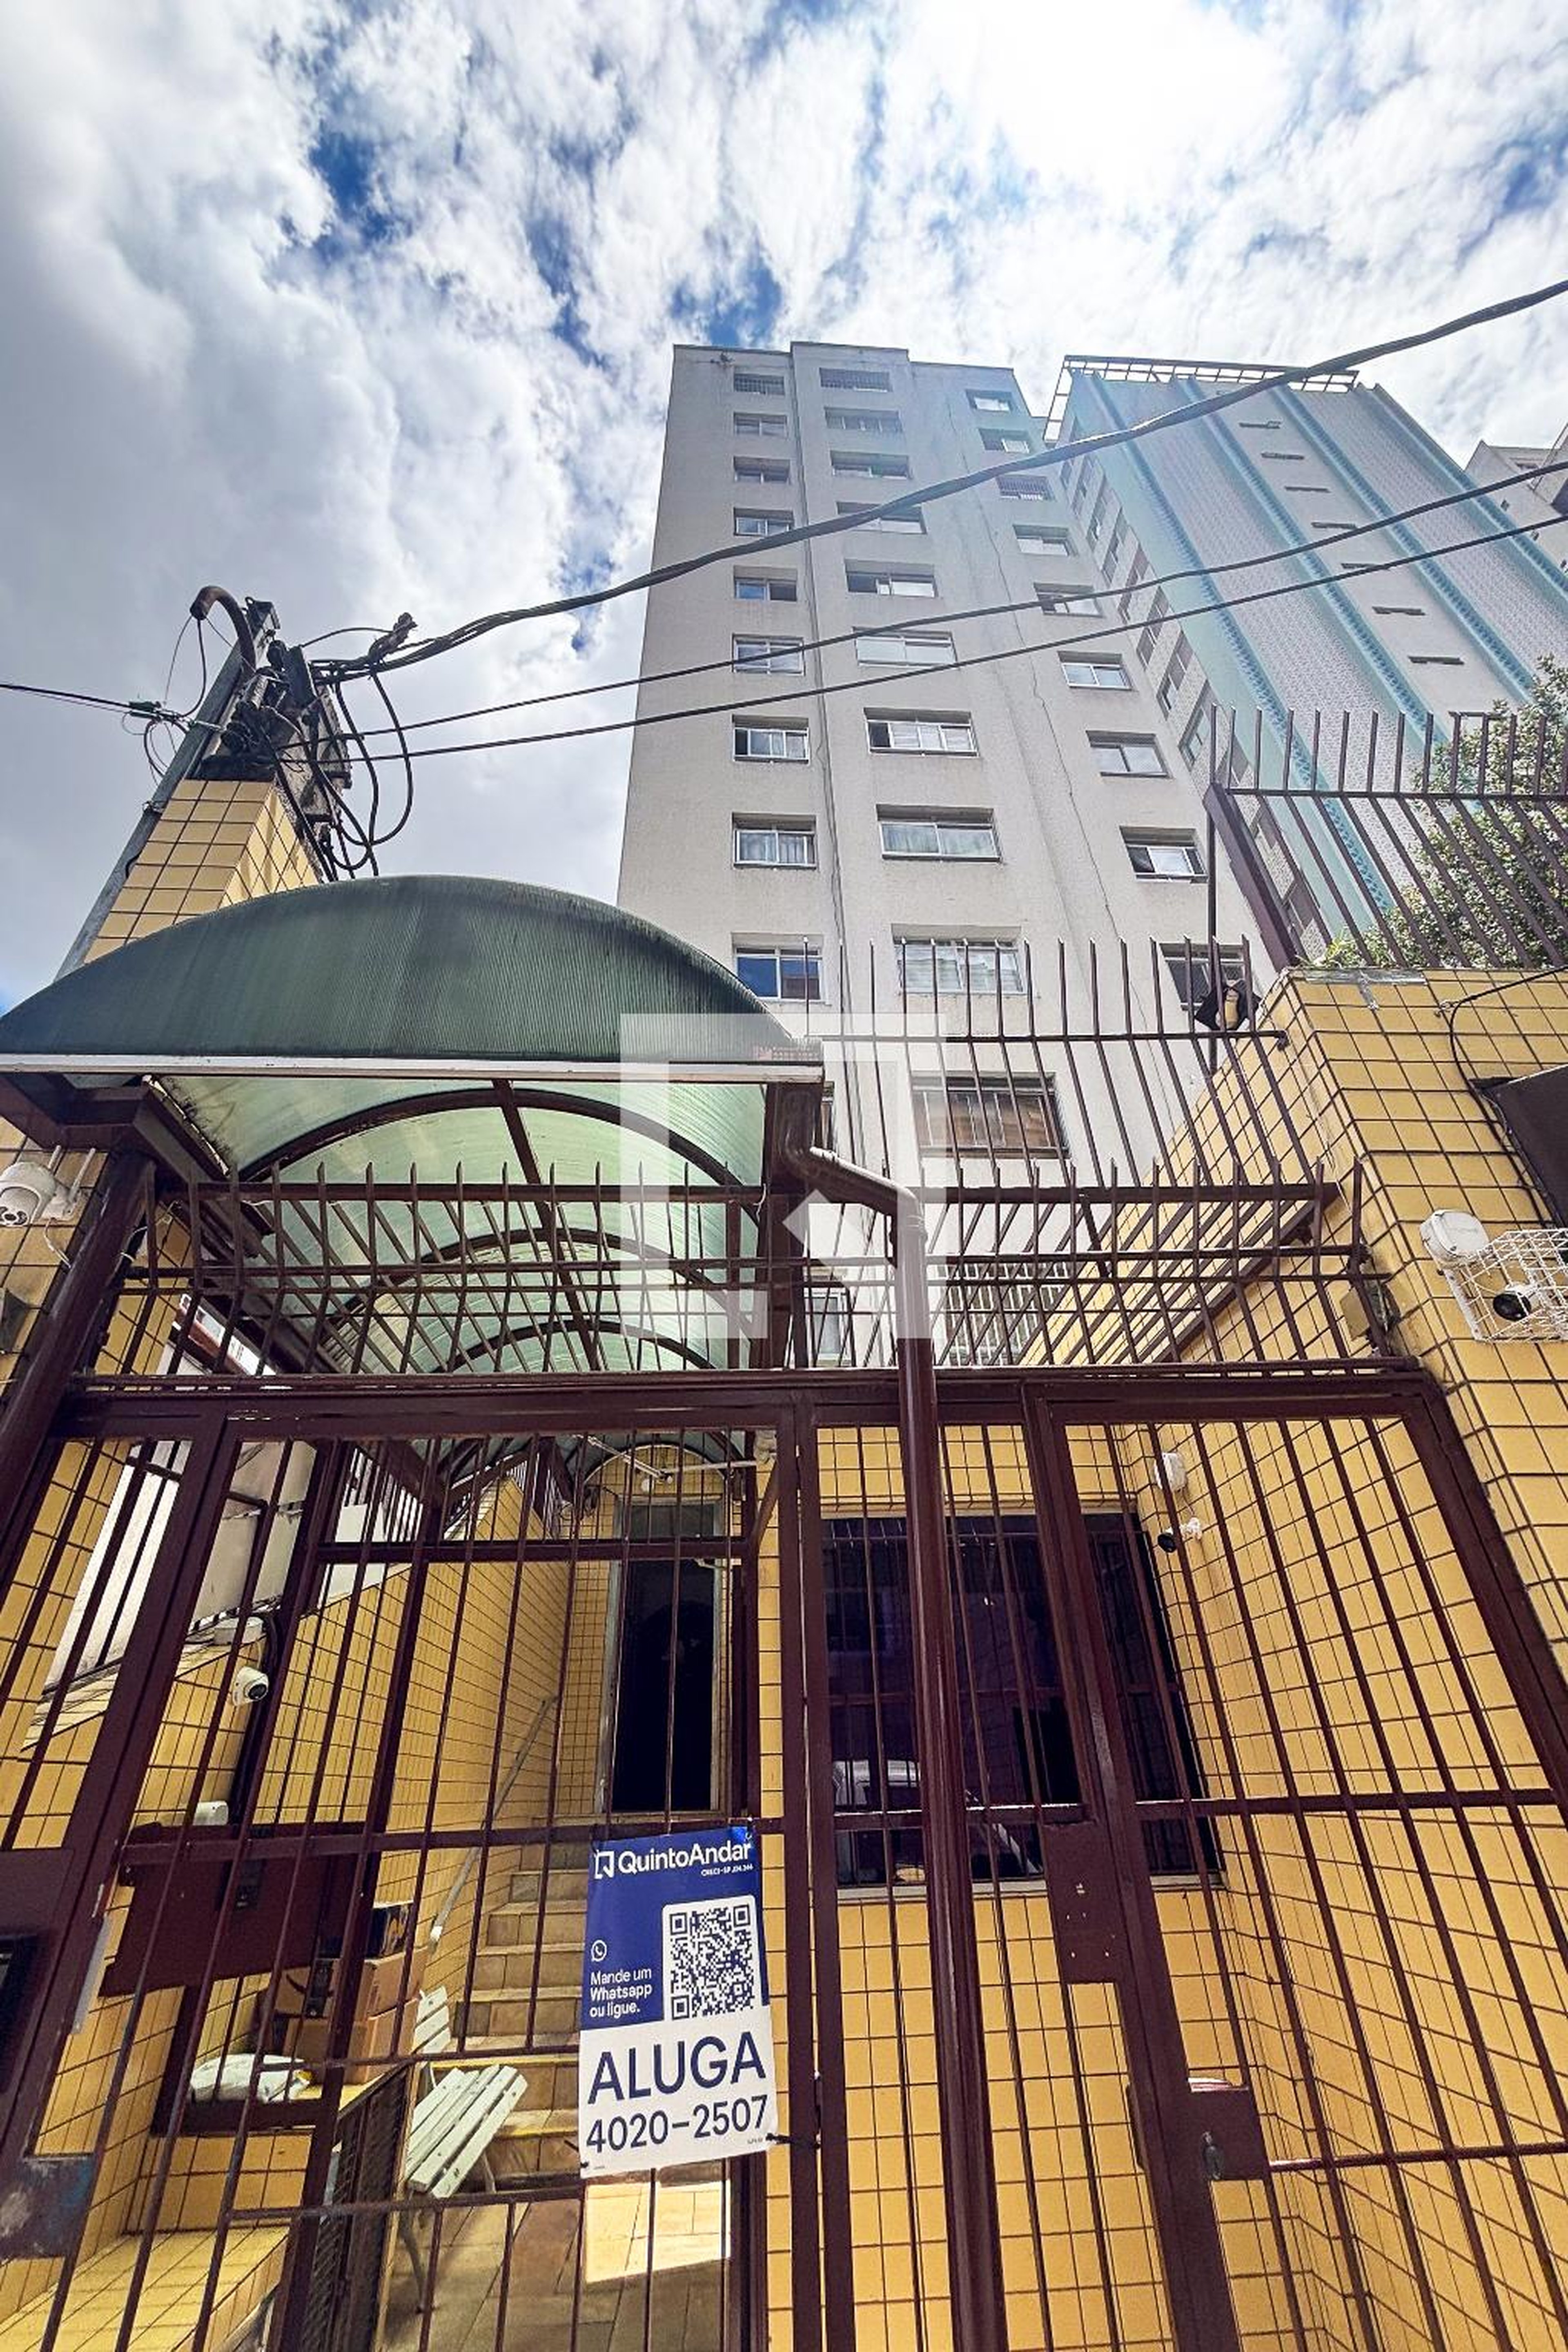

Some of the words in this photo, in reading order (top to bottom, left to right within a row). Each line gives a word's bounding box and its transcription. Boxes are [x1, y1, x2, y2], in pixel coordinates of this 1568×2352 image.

[618, 1840, 751, 1874] QuintoAndar
[590, 1969, 631, 1985] Mande
[633, 1968, 652, 1980] um
[590, 1984, 653, 2001] Whatsapp
[590, 2006, 605, 2017] ou
[607, 2002, 640, 2019] ligue.
[588, 2031, 766, 2104] ALUGA
[586, 2094, 768, 2153] 4020-2507
